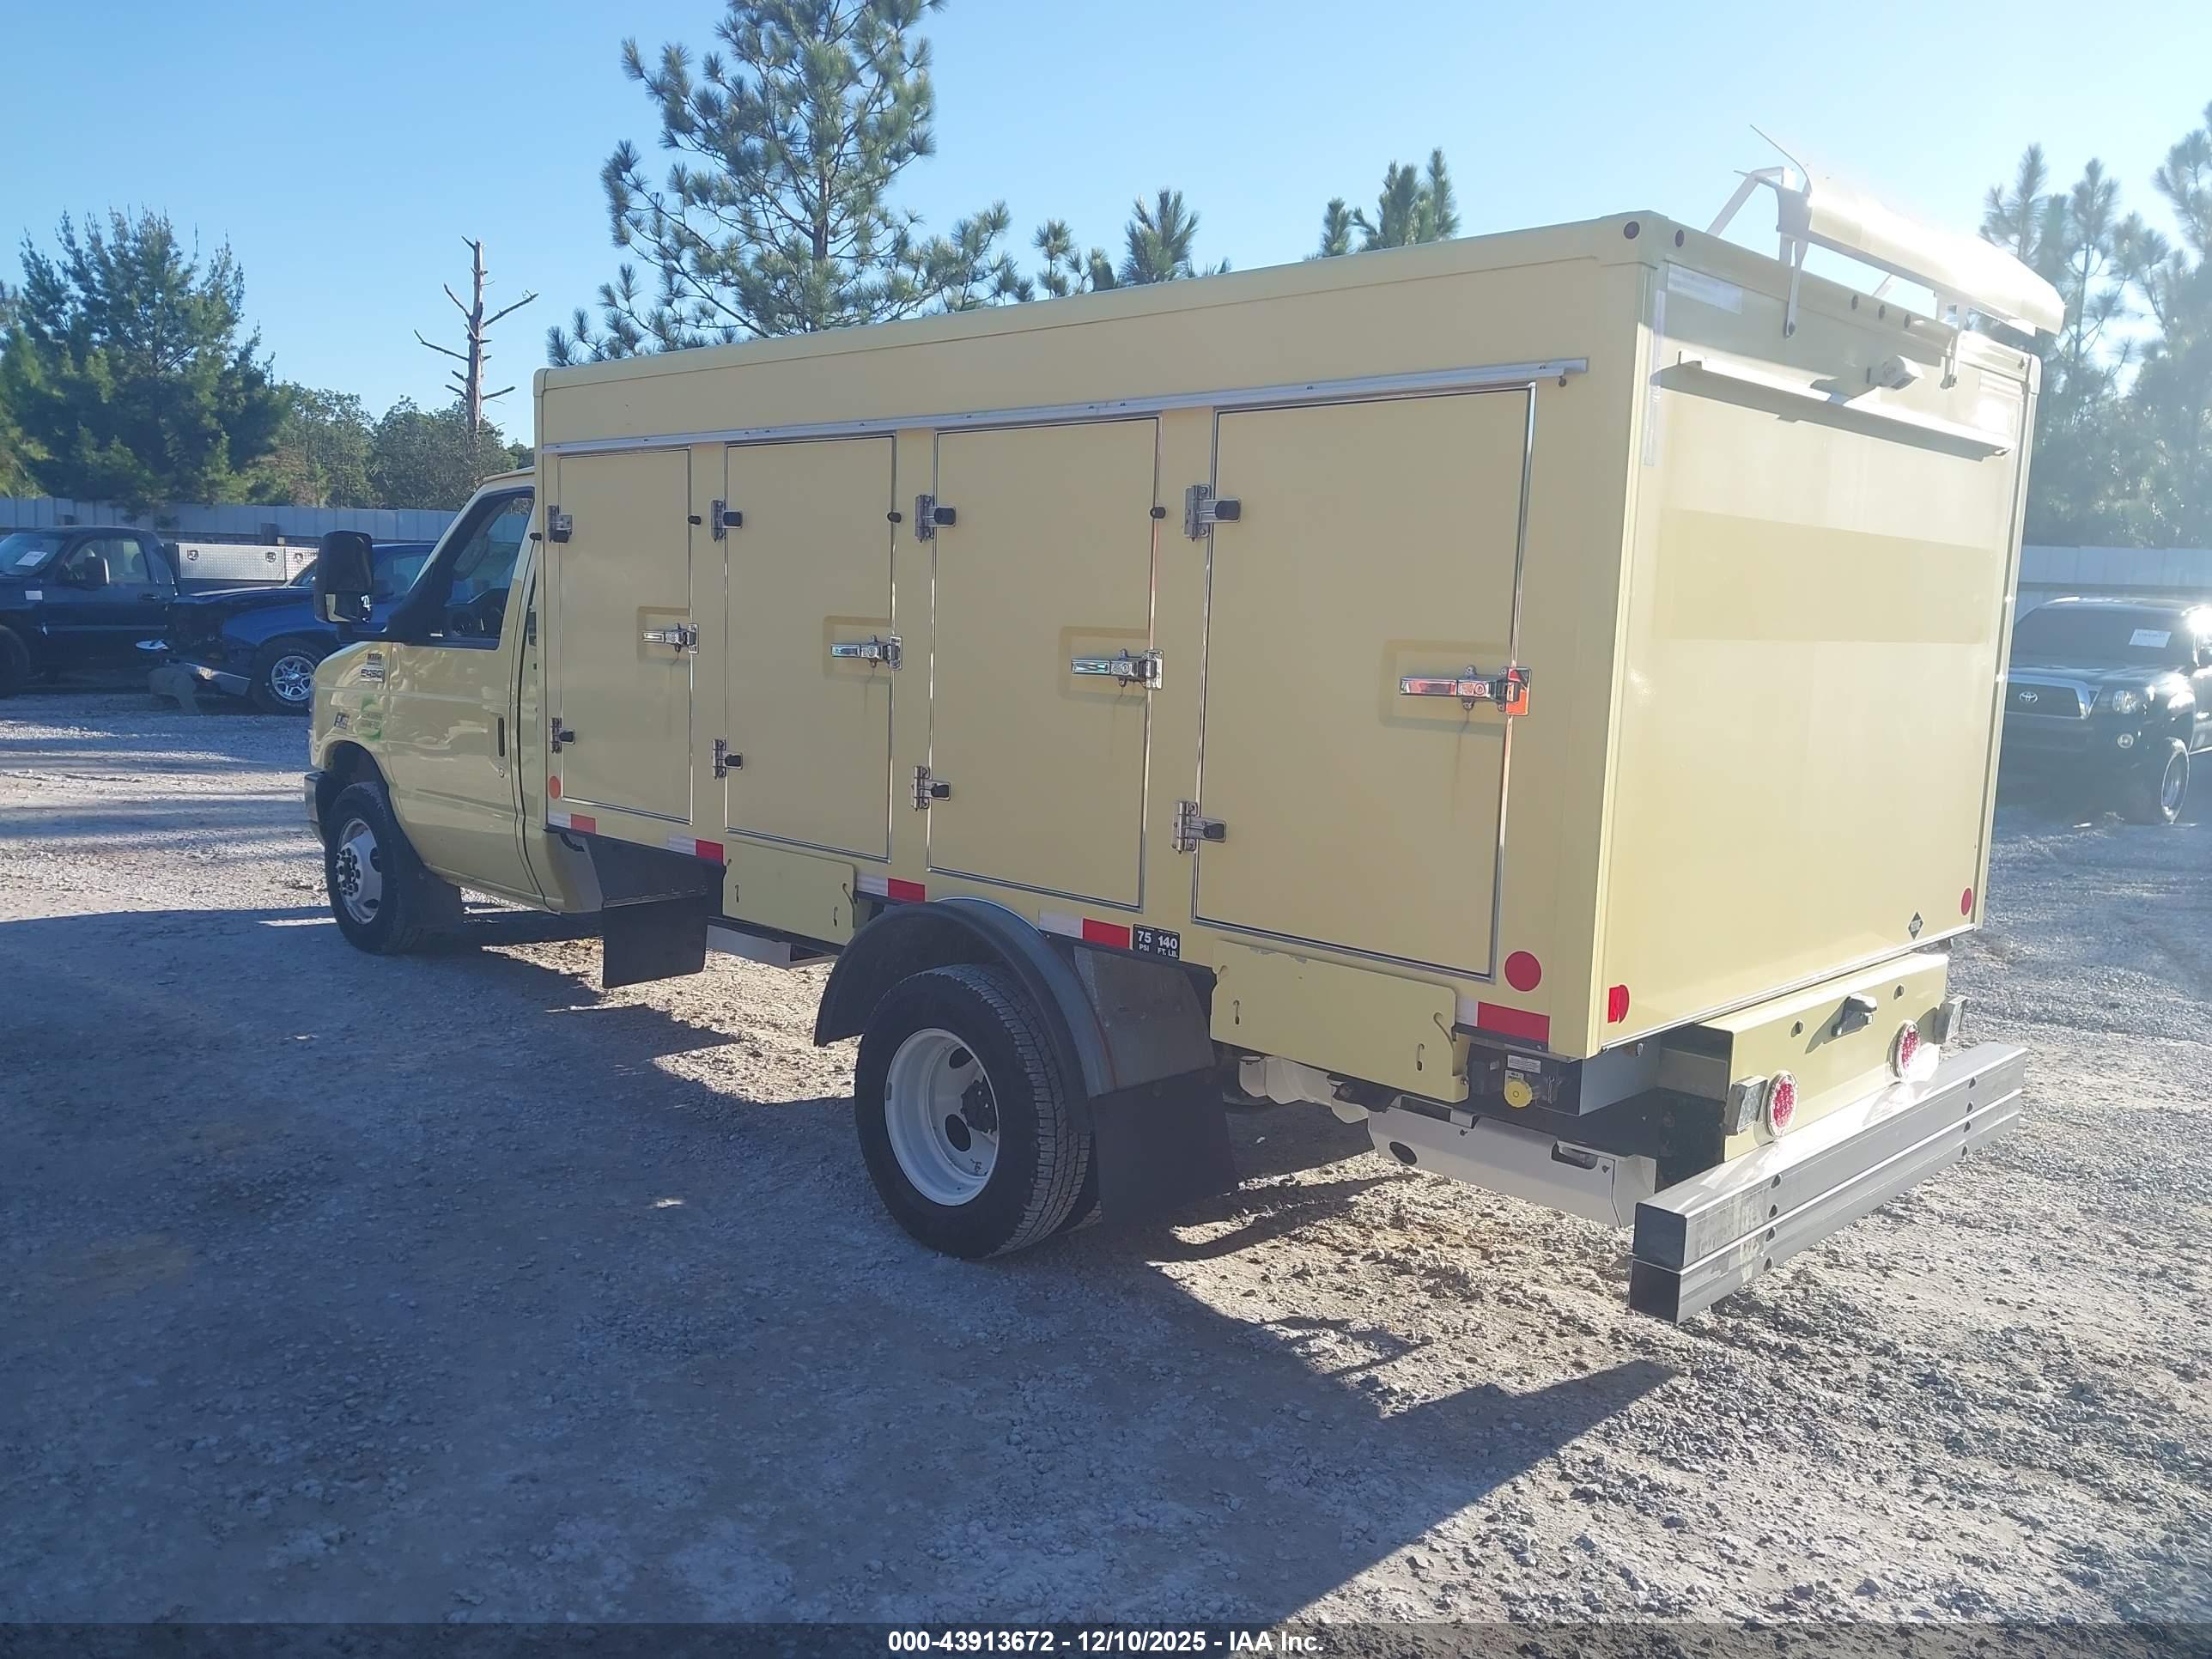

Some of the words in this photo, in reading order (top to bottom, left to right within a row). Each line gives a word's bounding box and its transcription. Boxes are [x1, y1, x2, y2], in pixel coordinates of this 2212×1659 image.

[1137, 931, 1152, 943] 75
[1158, 935, 1177, 949] 140
[1139, 943, 1150, 952] PSI
[1157, 947, 1167, 956] FT.
[1168, 949, 1178, 958] LB.
